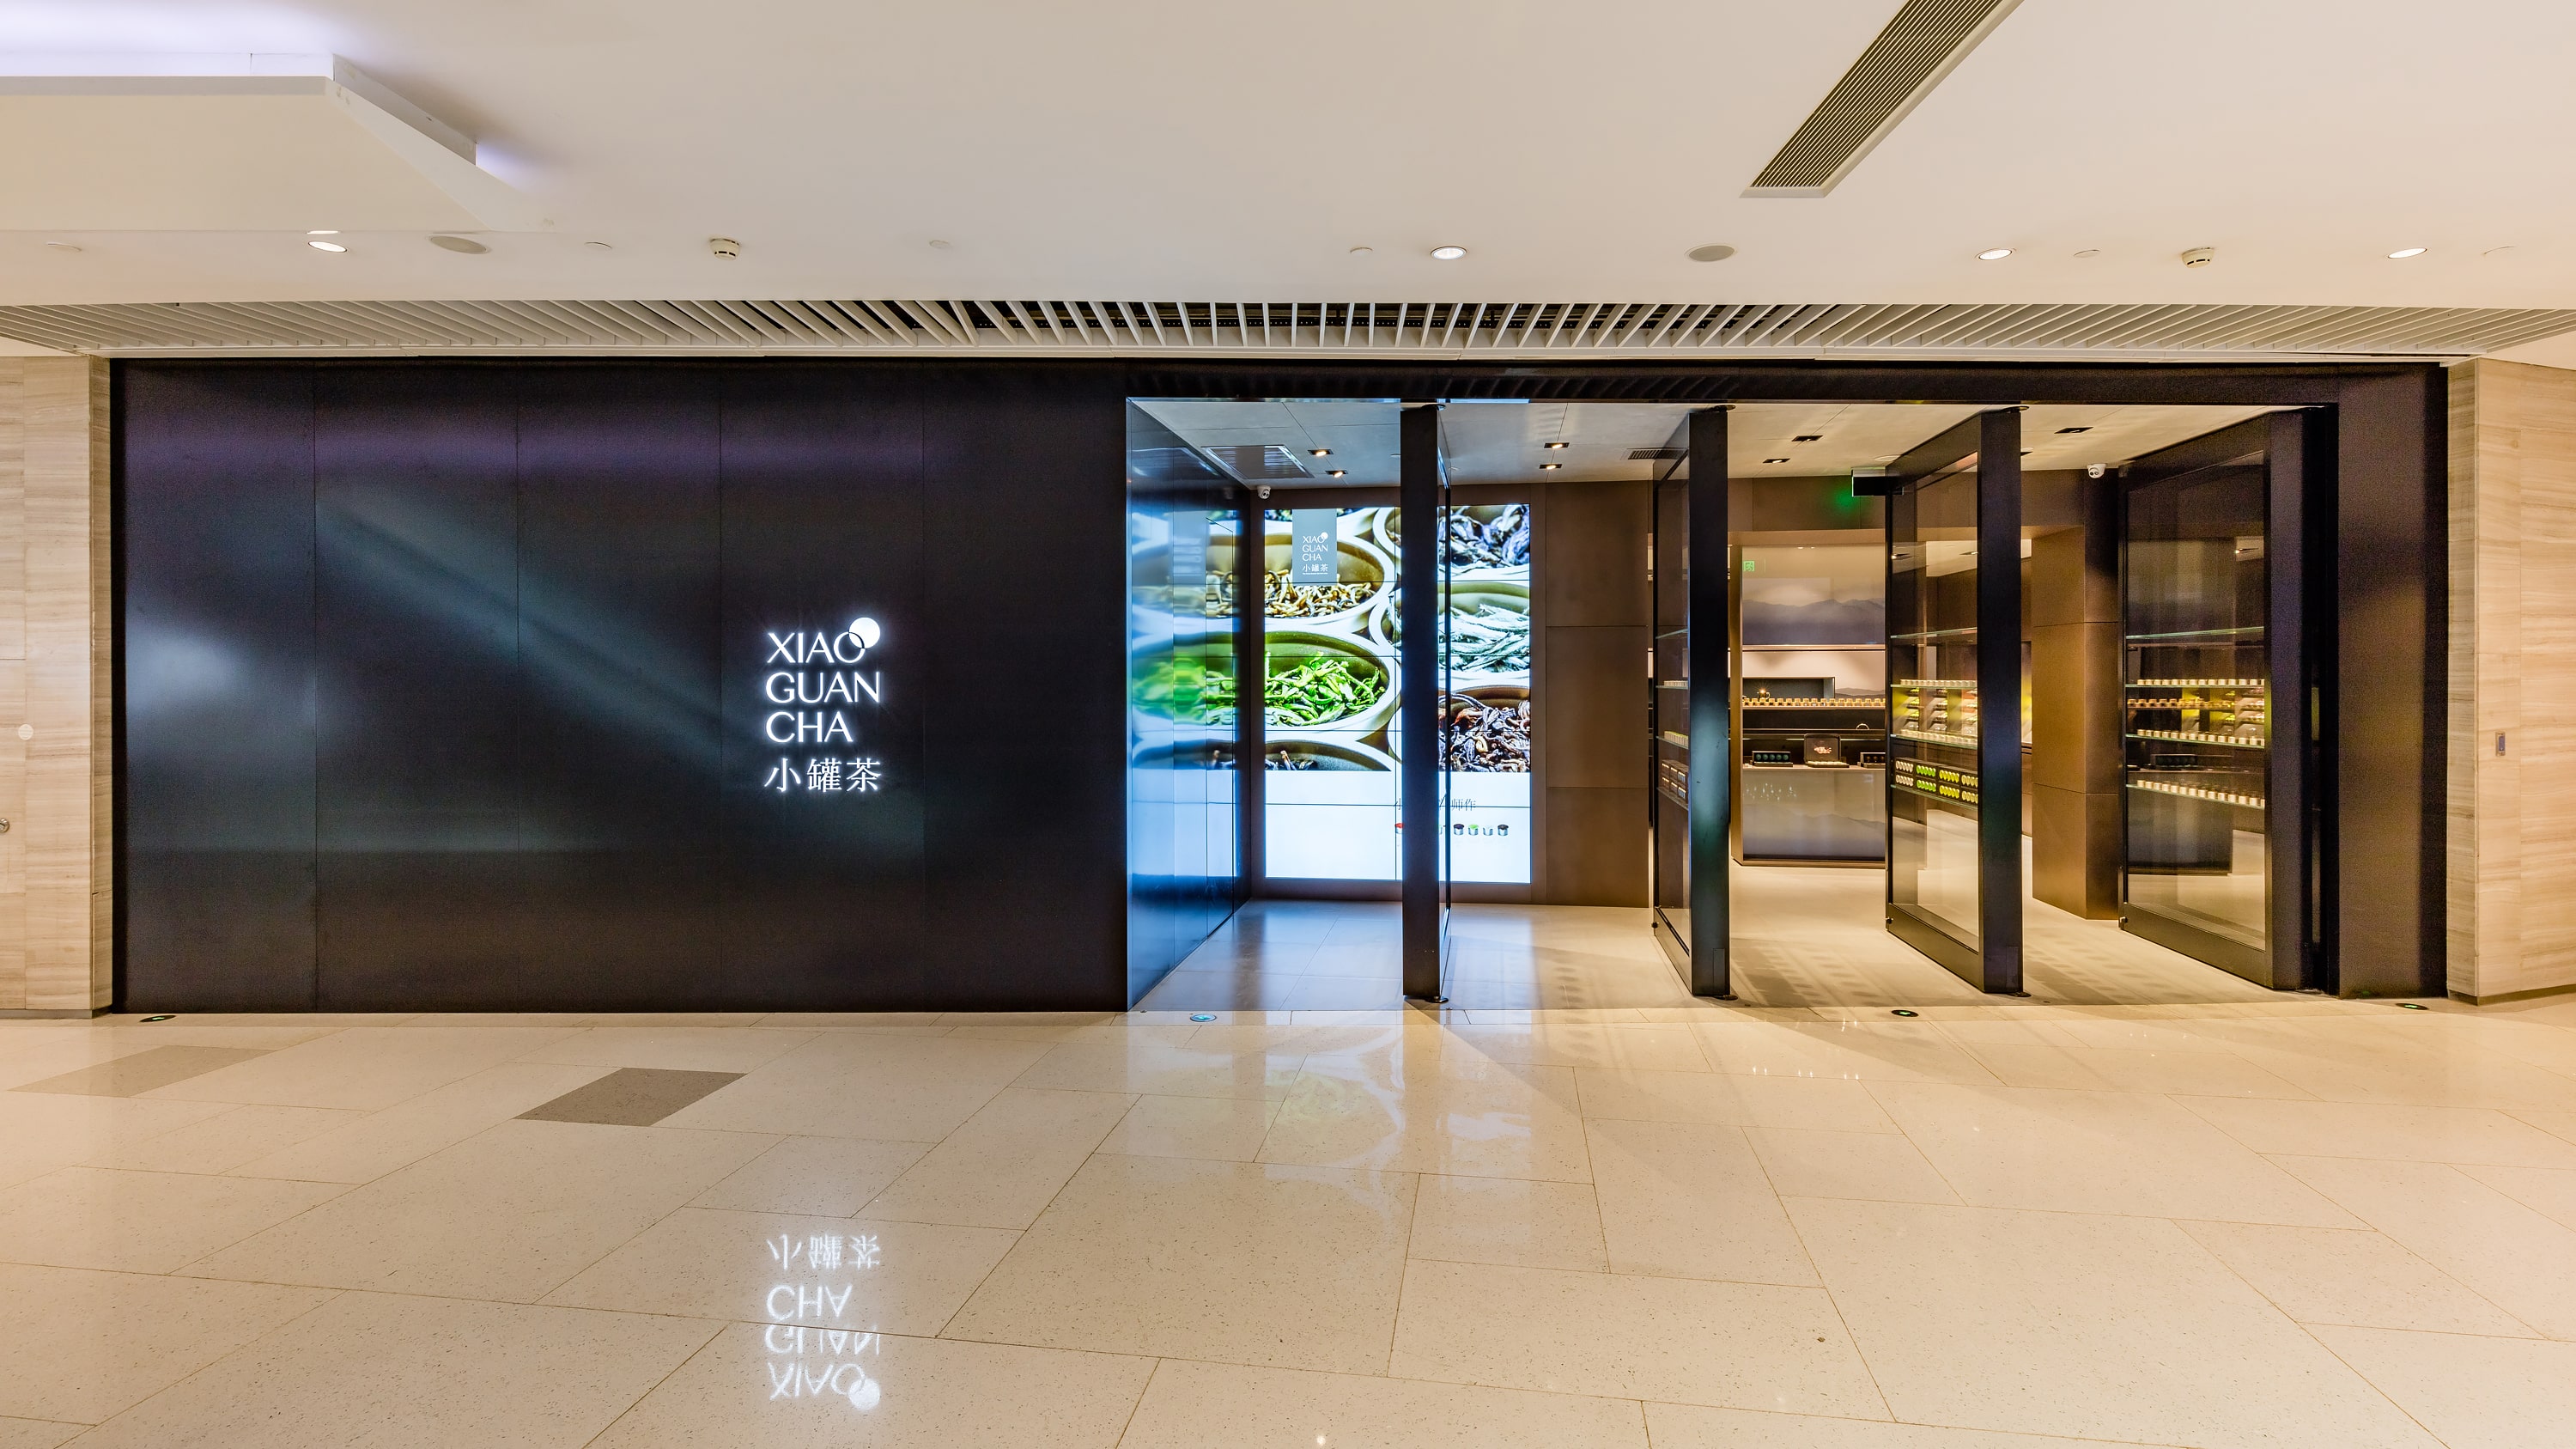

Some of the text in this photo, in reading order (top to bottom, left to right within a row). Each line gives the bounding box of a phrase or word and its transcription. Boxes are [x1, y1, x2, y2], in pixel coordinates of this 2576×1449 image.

[1302, 544, 1328, 552] GUAN
[1303, 535, 1325, 544] XIAO
[1302, 553, 1322, 562] CHA
[1302, 563, 1328, 572] 小罐茶
[767, 631, 866, 663] XIAO
[766, 672, 881, 703] GUAN
[766, 711, 854, 743] CHA
[764, 758, 882, 792] 小罐茶
